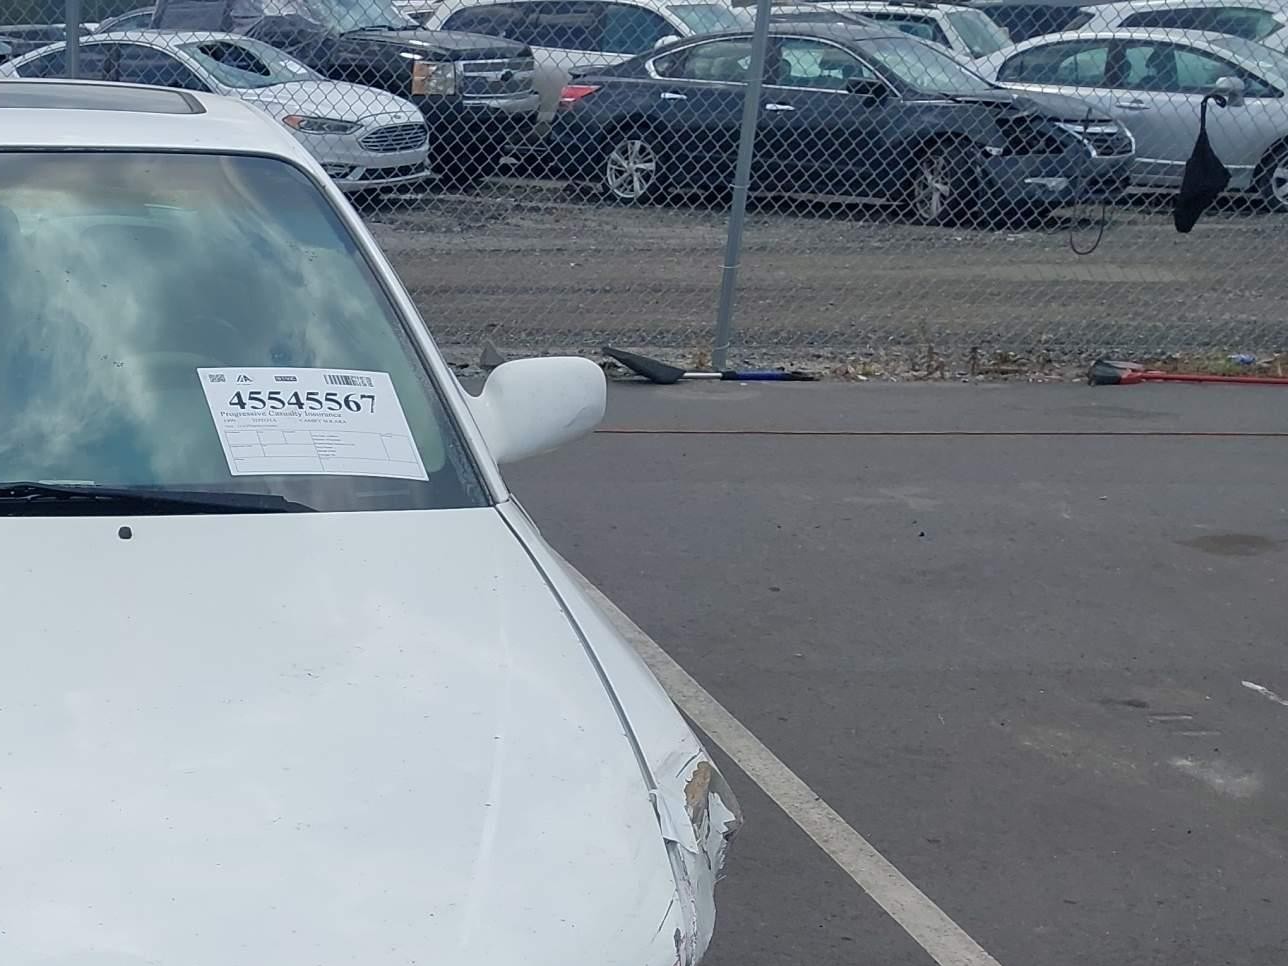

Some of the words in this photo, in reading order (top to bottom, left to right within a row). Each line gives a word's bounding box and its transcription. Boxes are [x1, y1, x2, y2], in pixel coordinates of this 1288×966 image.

[228, 390, 375, 414] 45545567
[268, 410, 302, 418] Casualty
[304, 410, 342, 418] Insurance
